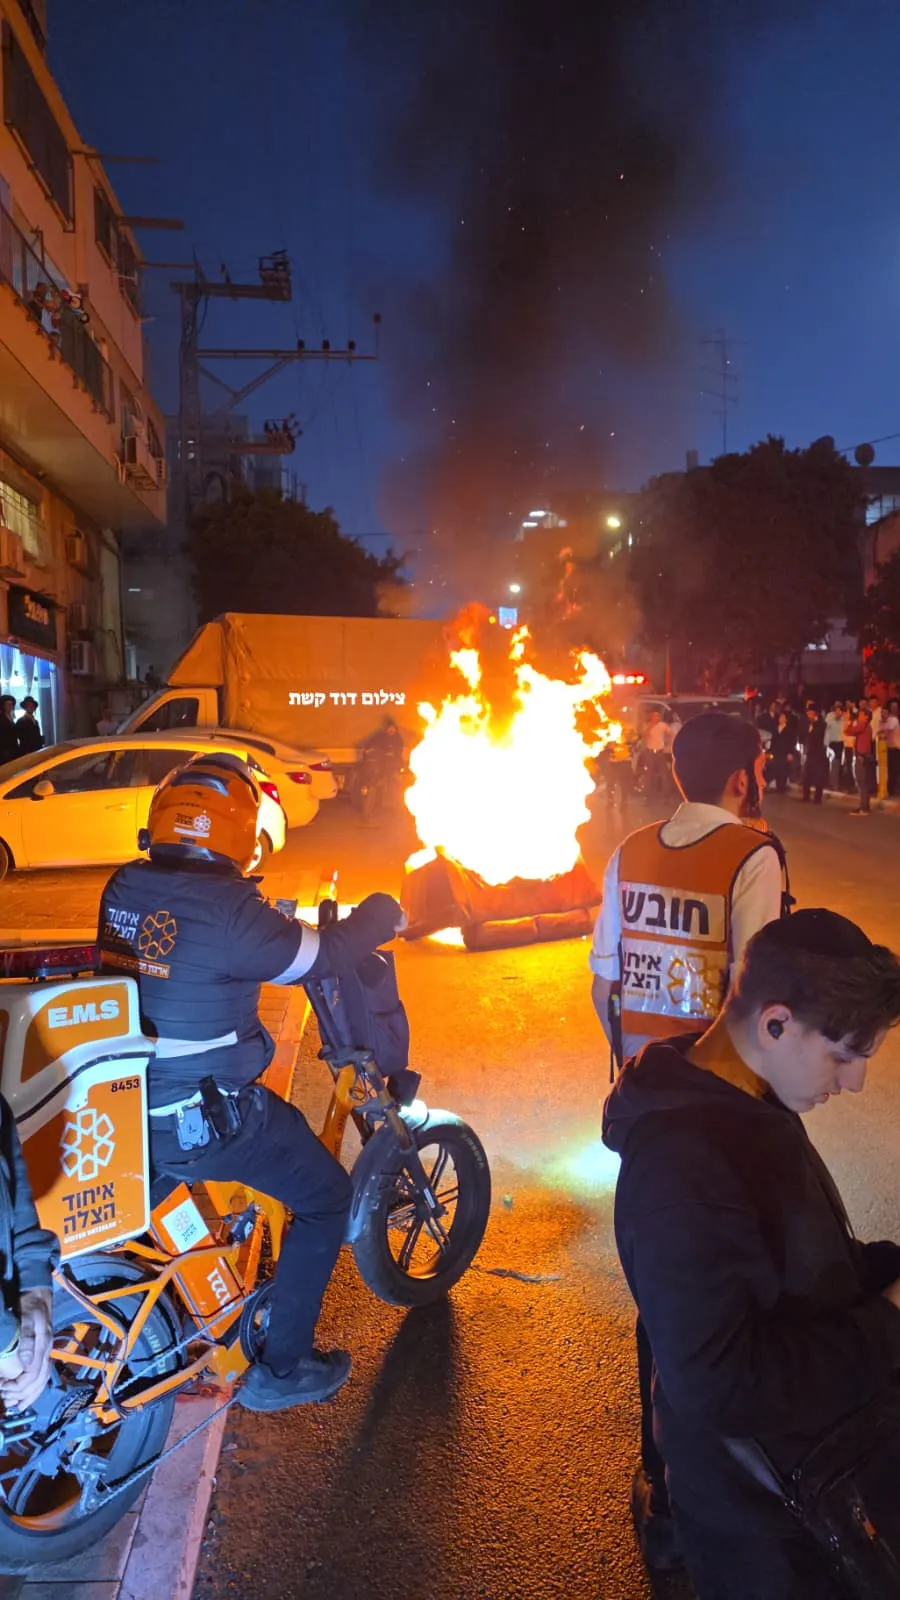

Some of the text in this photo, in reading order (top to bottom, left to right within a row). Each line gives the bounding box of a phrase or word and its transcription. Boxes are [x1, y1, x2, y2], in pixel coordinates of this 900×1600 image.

[108, 908, 140, 926] איחוד
[622, 890, 709, 936] חובש
[104, 922, 137, 940] הצלה
[48, 1000, 119, 1028] E.M.S
[110, 1078, 140, 1093] 8453
[62, 1182, 115, 1211] איחוד
[63, 1202, 116, 1235] הצלה
